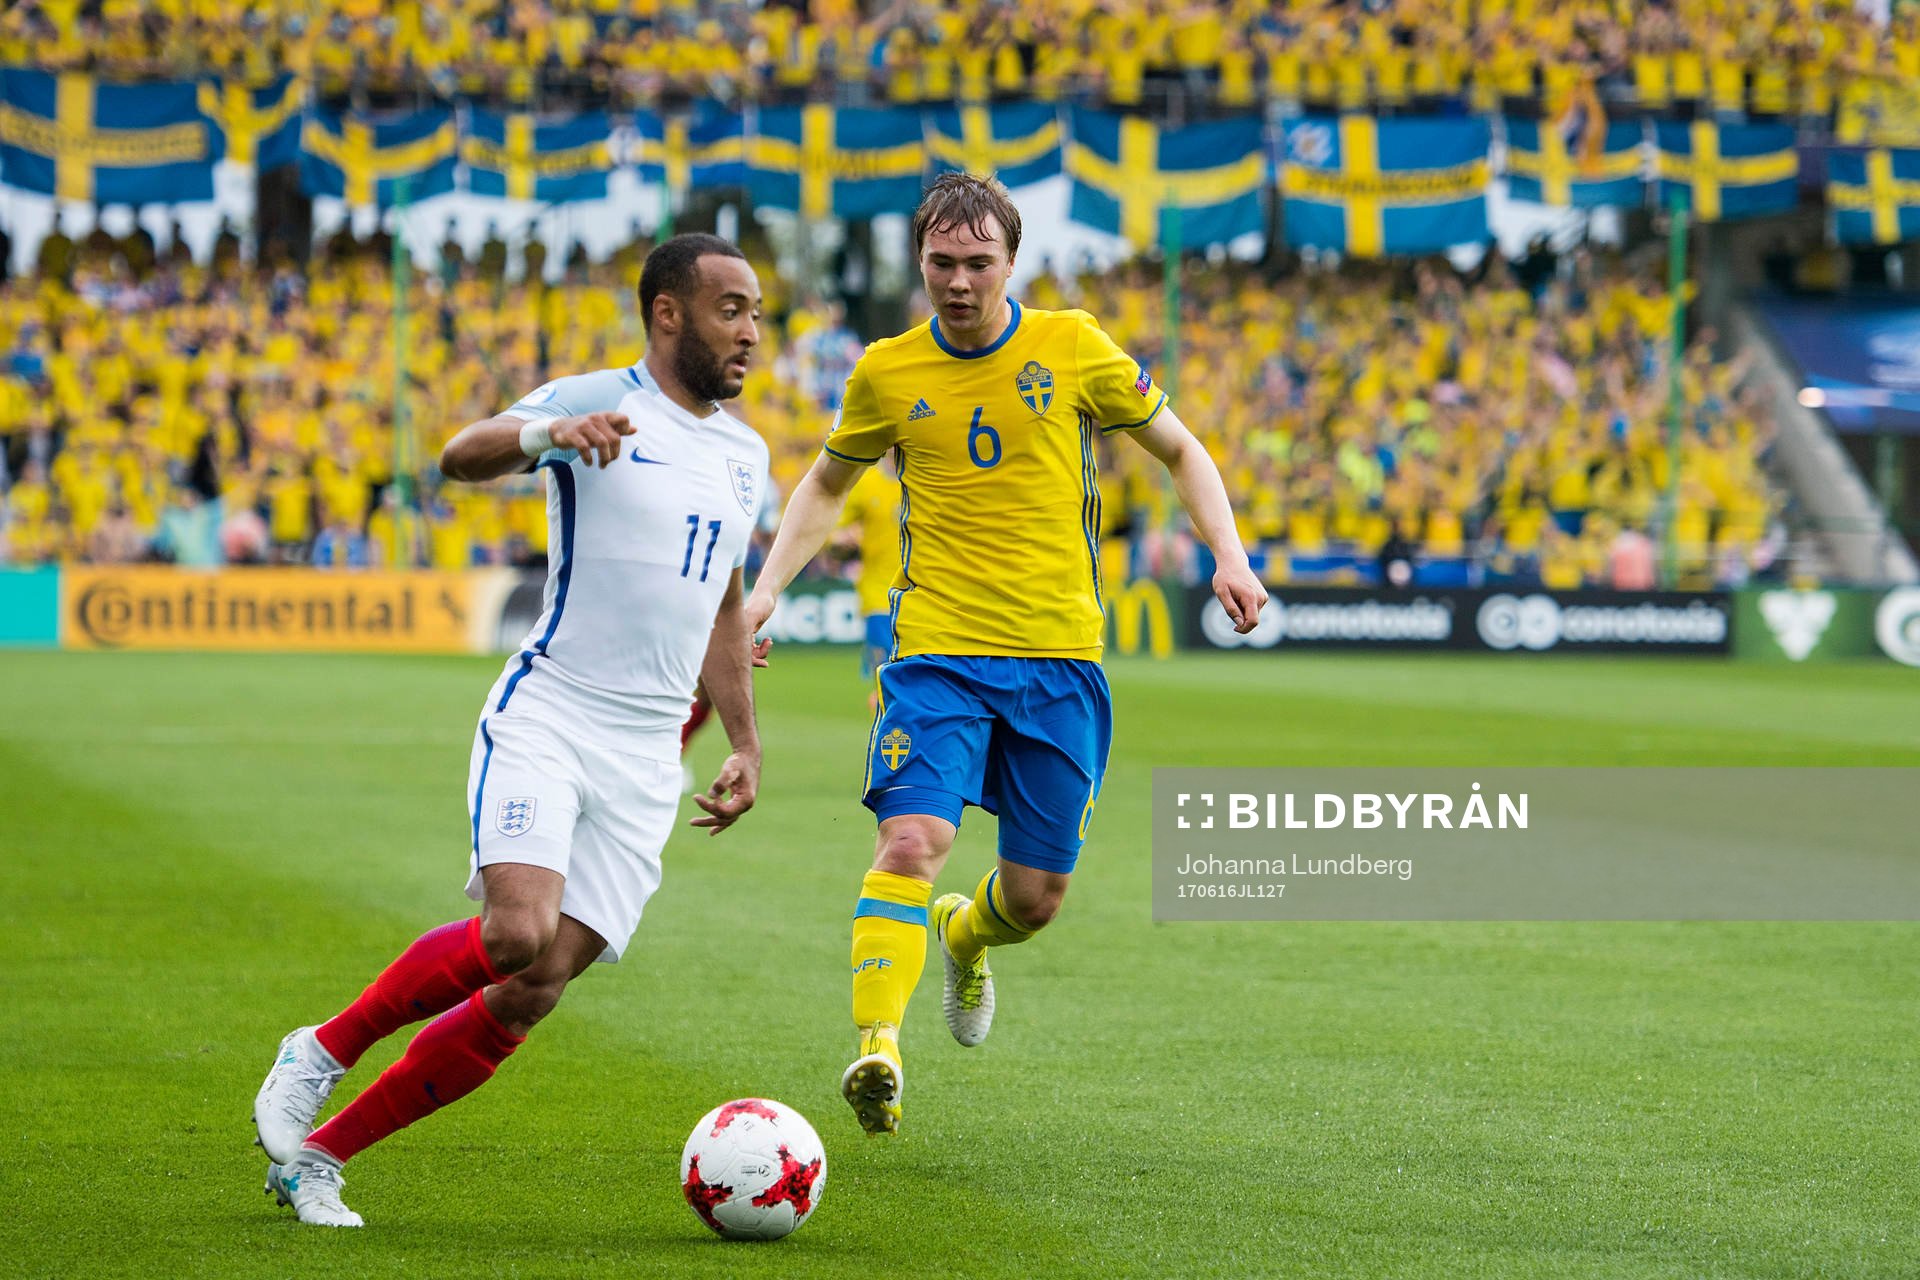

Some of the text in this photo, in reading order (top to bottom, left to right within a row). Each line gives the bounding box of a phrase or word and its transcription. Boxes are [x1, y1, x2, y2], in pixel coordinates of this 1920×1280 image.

[907, 409, 937, 422] adidas
[968, 406, 1002, 469] 6
[680, 514, 722, 583] 11
[76, 580, 414, 647] Continental
